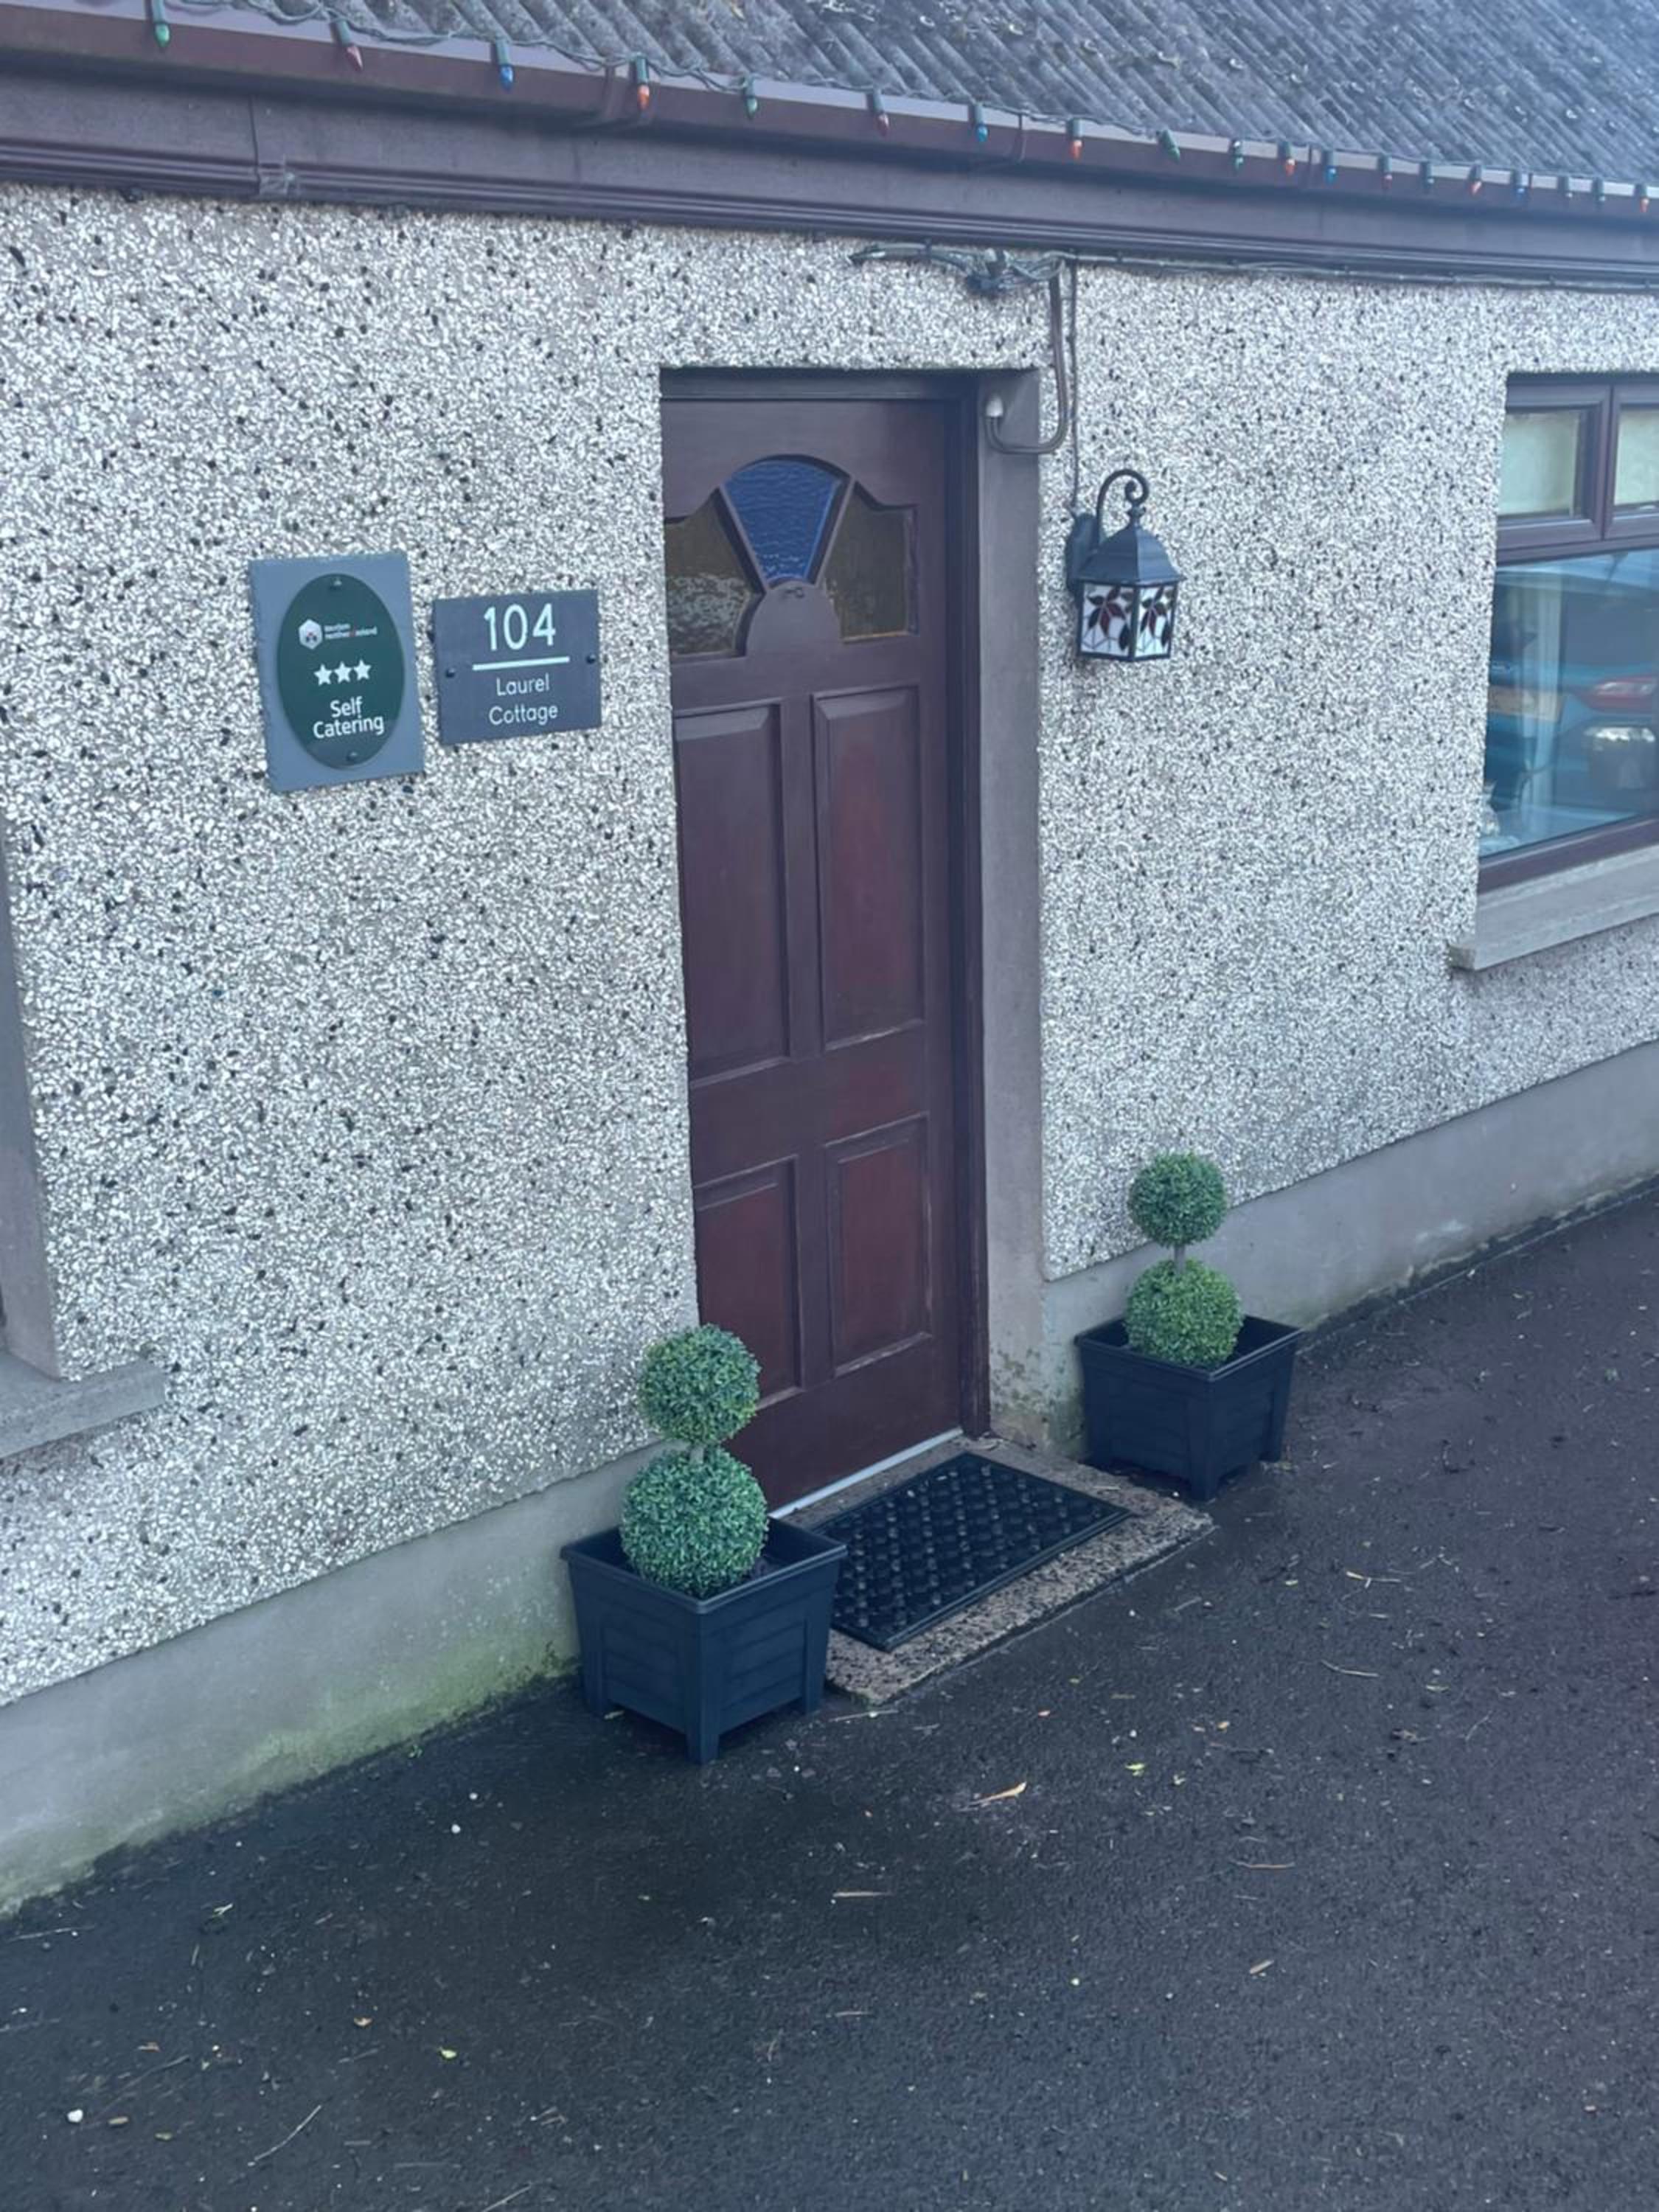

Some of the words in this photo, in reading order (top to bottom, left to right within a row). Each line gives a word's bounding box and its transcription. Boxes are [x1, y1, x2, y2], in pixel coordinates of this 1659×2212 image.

[484, 602, 557, 651] 104
[495, 672, 550, 697] Laurel
[330, 695, 363, 718] Self
[488, 703, 559, 726] Cottage
[313, 715, 385, 740] Catering
